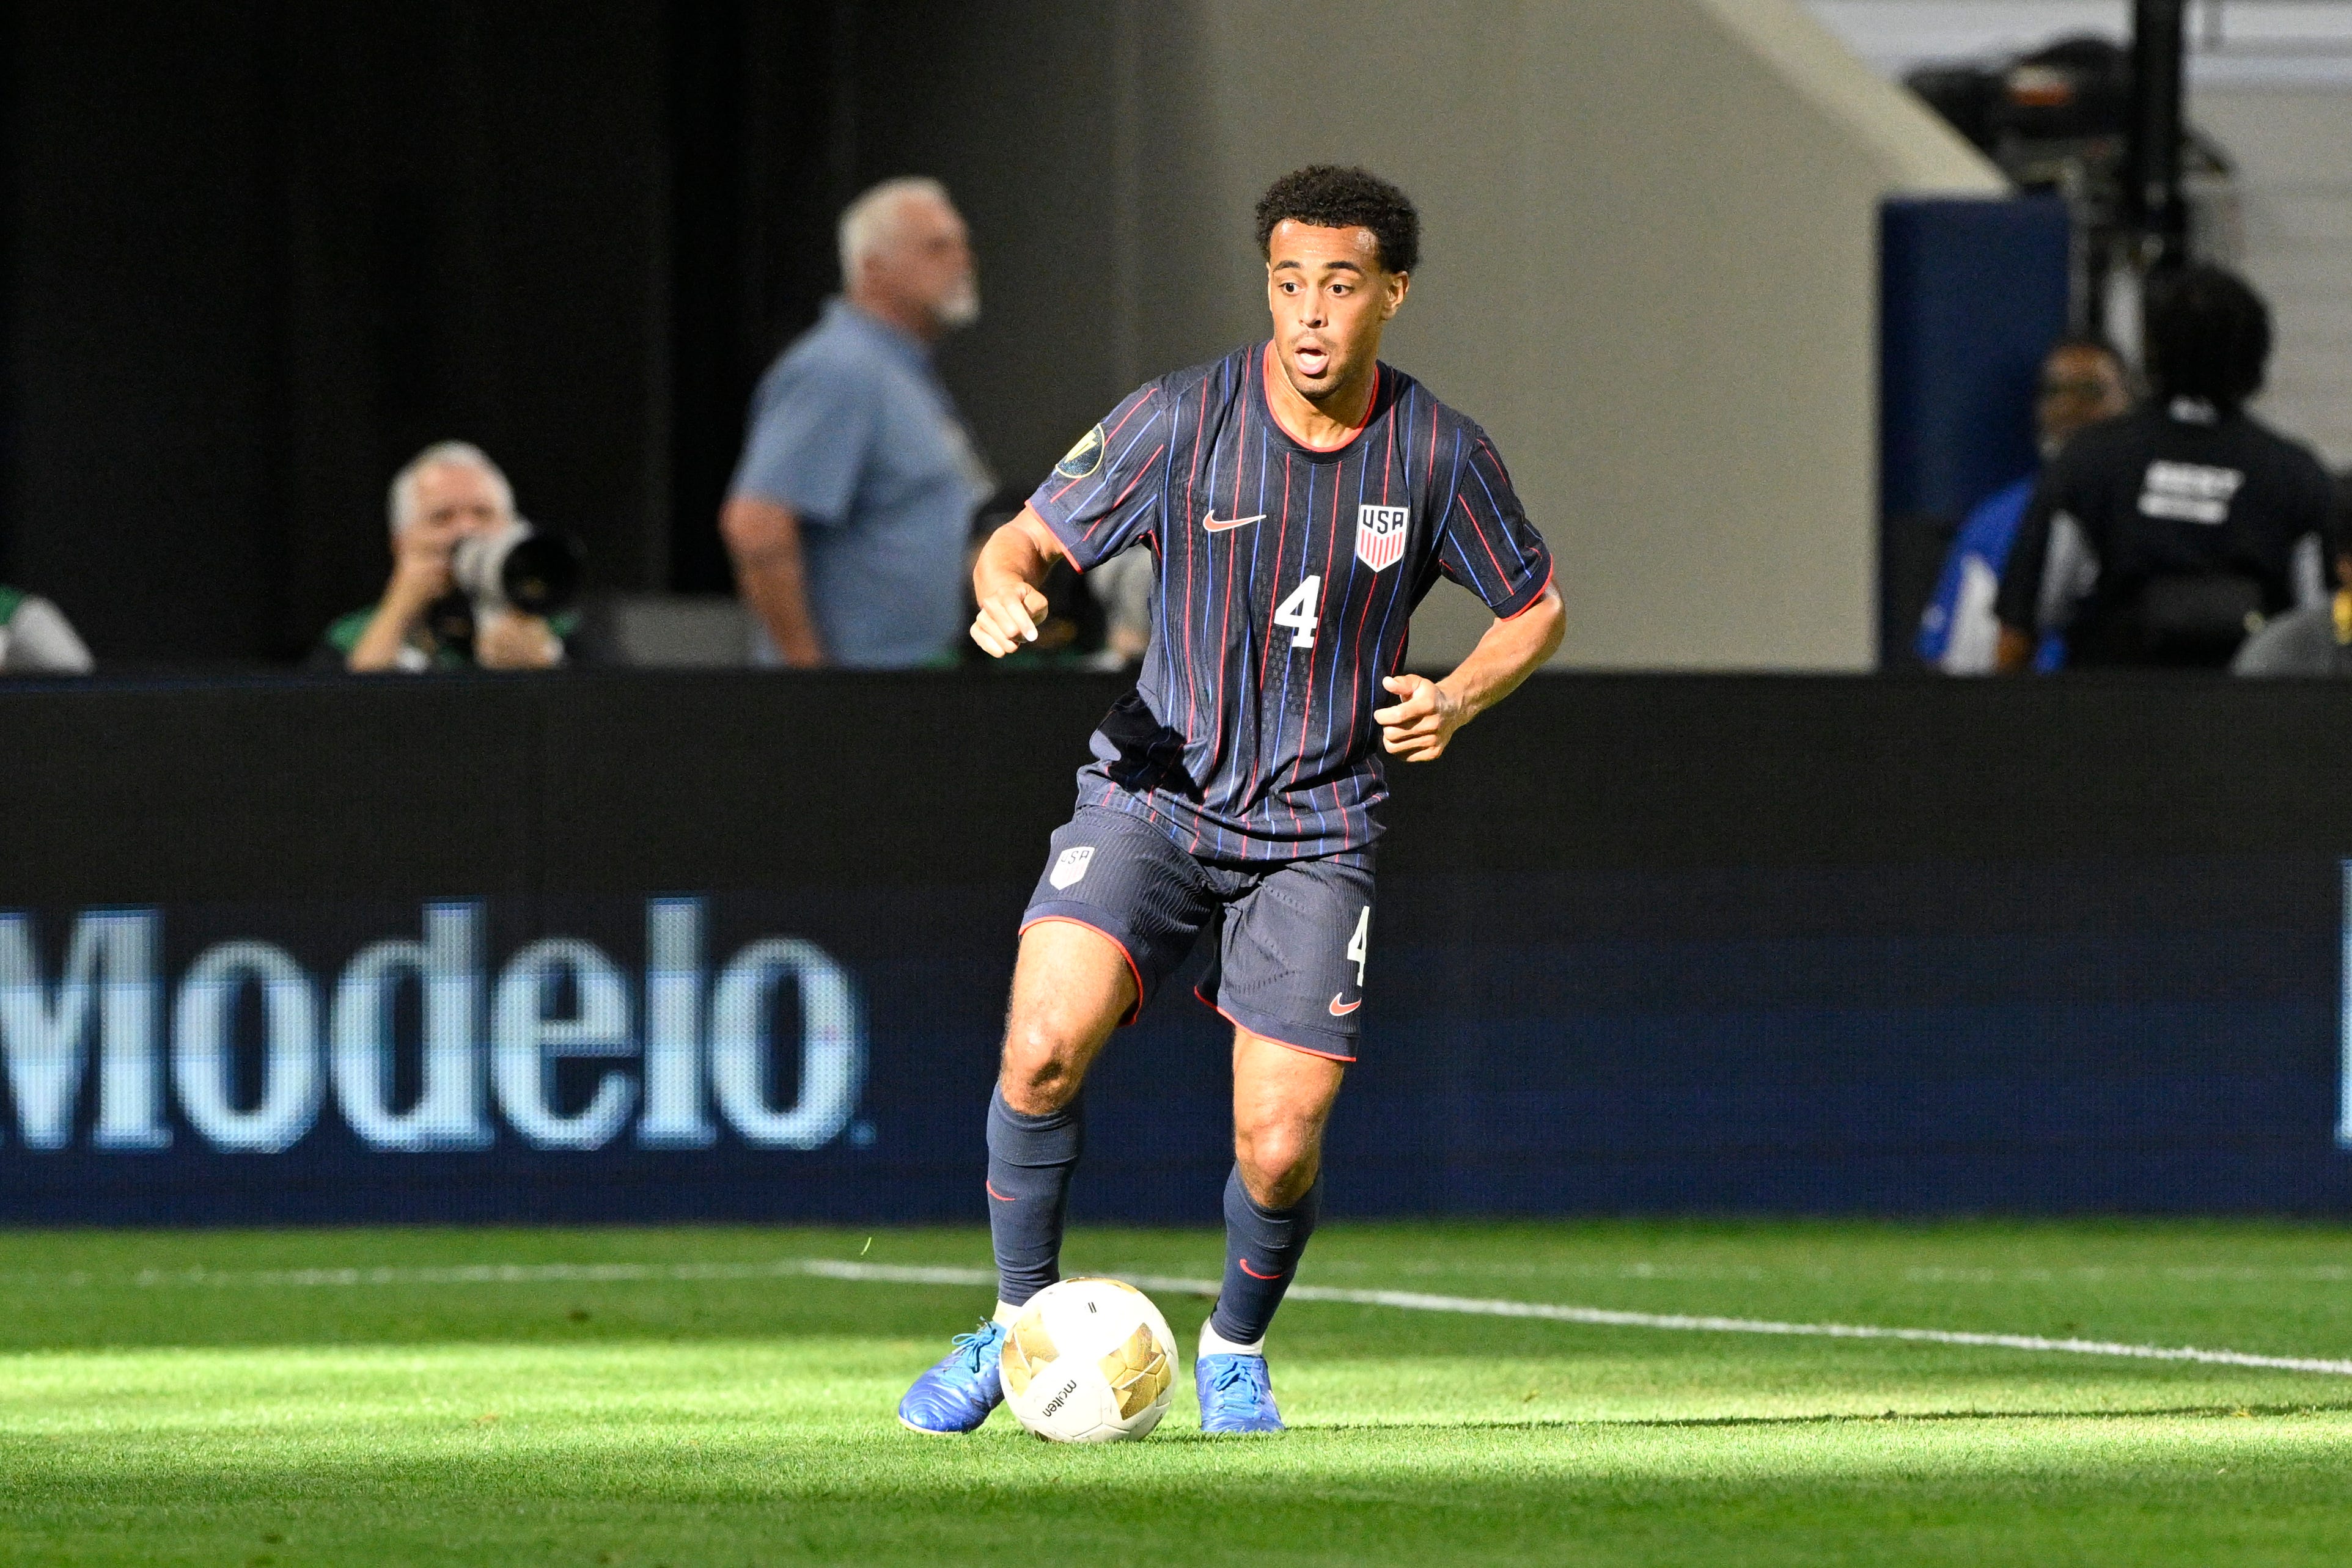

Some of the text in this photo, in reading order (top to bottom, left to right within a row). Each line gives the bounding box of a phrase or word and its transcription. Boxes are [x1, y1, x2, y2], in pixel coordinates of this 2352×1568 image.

[1362, 509, 1404, 534] USA
[1274, 575, 1320, 648] 4
[1060, 850, 1090, 864] USA
[1347, 905, 1370, 987] 4
[1042, 1379, 1077, 1417] molten
